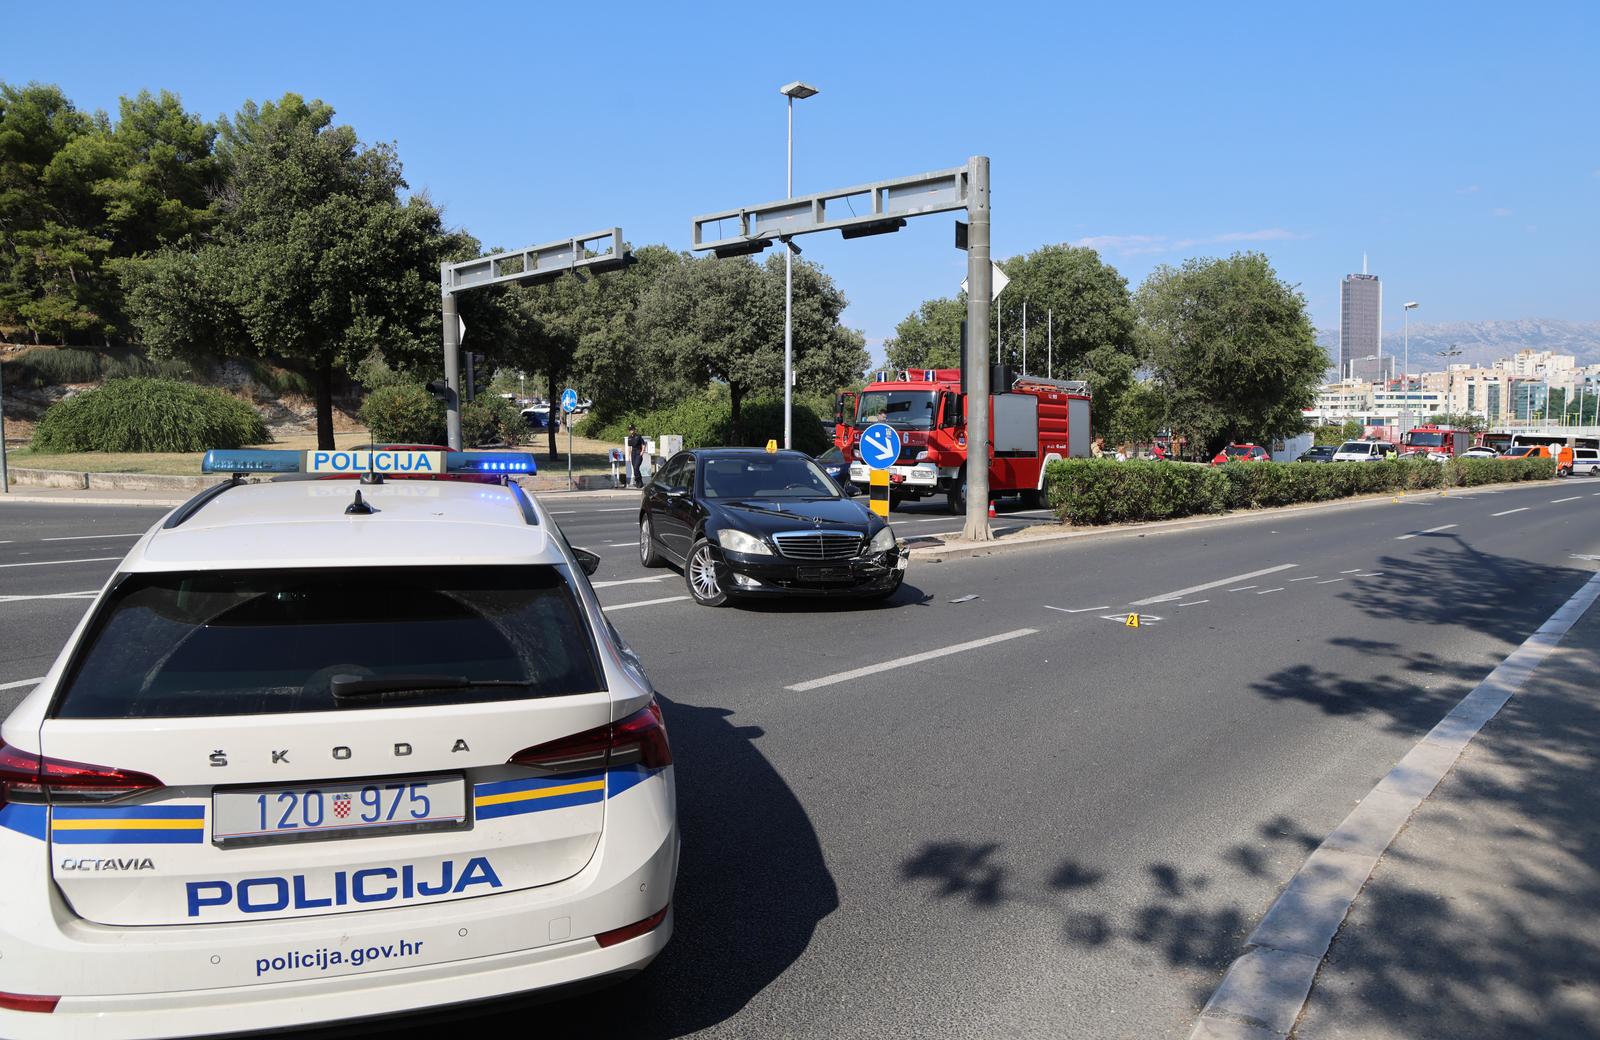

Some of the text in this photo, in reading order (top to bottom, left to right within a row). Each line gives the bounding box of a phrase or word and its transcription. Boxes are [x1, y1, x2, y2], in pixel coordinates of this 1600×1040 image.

[903, 431, 909, 444] 6
[314, 452, 433, 471] POLICIJA
[257, 782, 431, 831] 120 975
[61, 858, 155, 871] OCTAVIA
[186, 856, 503, 917] POLICIJA
[255, 938, 424, 977] policija.gov.hr
